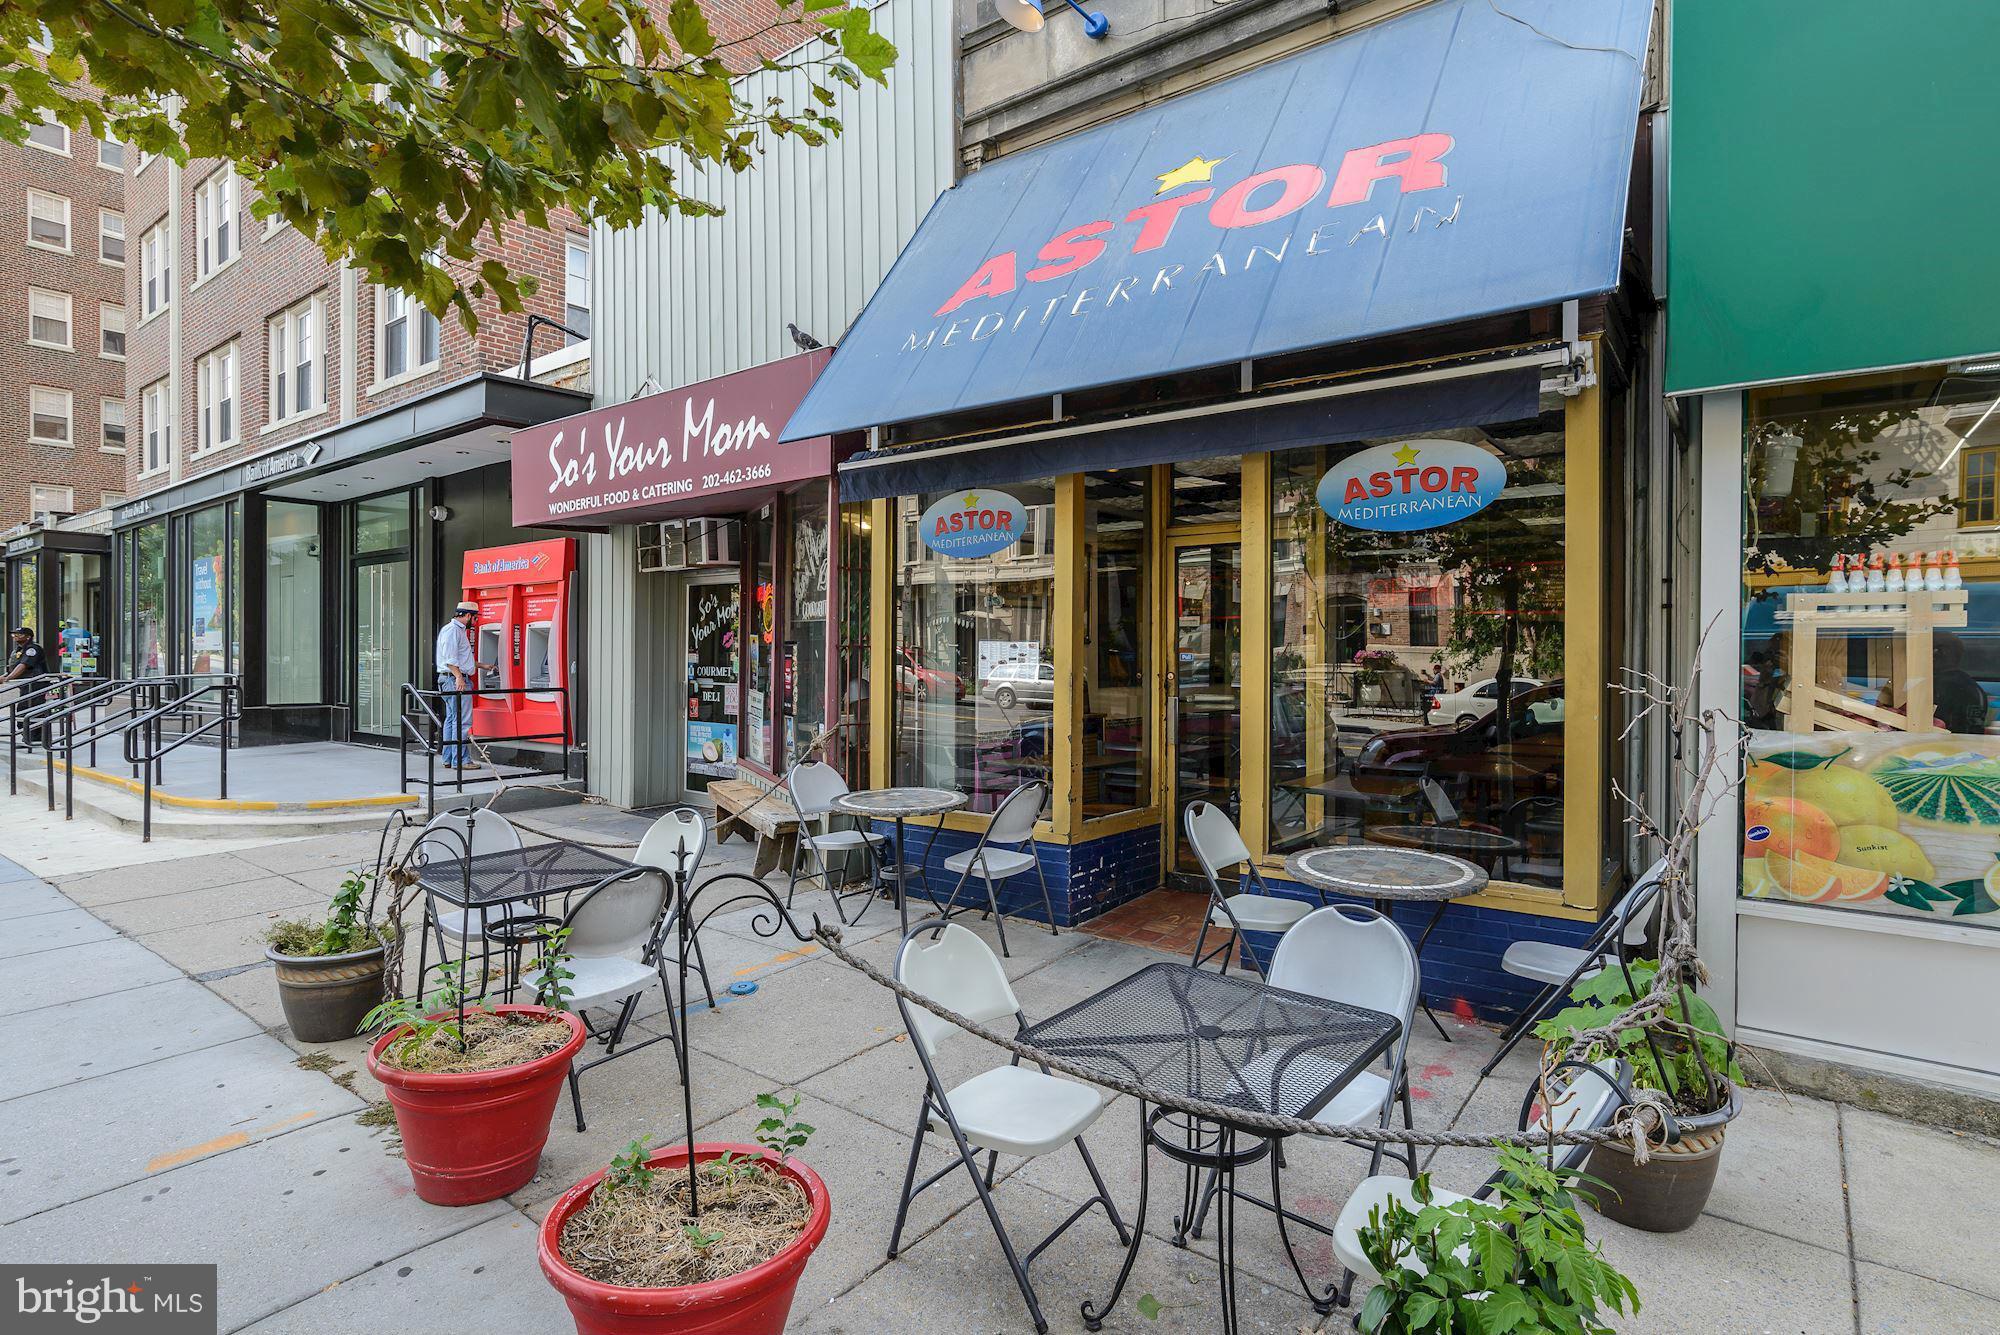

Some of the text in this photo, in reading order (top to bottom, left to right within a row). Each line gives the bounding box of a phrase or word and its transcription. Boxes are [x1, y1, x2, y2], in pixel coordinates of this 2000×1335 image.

[933, 132, 1456, 318] ASTOR
[899, 194, 1464, 356] MEDITERRANEAN
[548, 396, 771, 494] So's Your Mom
[245, 451, 298, 481] Bank of America
[548, 463, 772, 515] WONDERFUL FOOD & CATERING 202-462-3666
[1343, 466, 1480, 505] ASTOR
[1337, 494, 1482, 520] MEDITERRANEAN
[934, 509, 1013, 537] ASTOR
[931, 532, 1014, 549] MEDITERRANEAN
[195, 562, 208, 576] Travel
[474, 557, 529, 574] Bank of America
[698, 594, 718, 621] So's
[691, 621, 716, 649] Your
[702, 691, 720, 702] DELI
[1856, 843, 1888, 853] Sunkist
